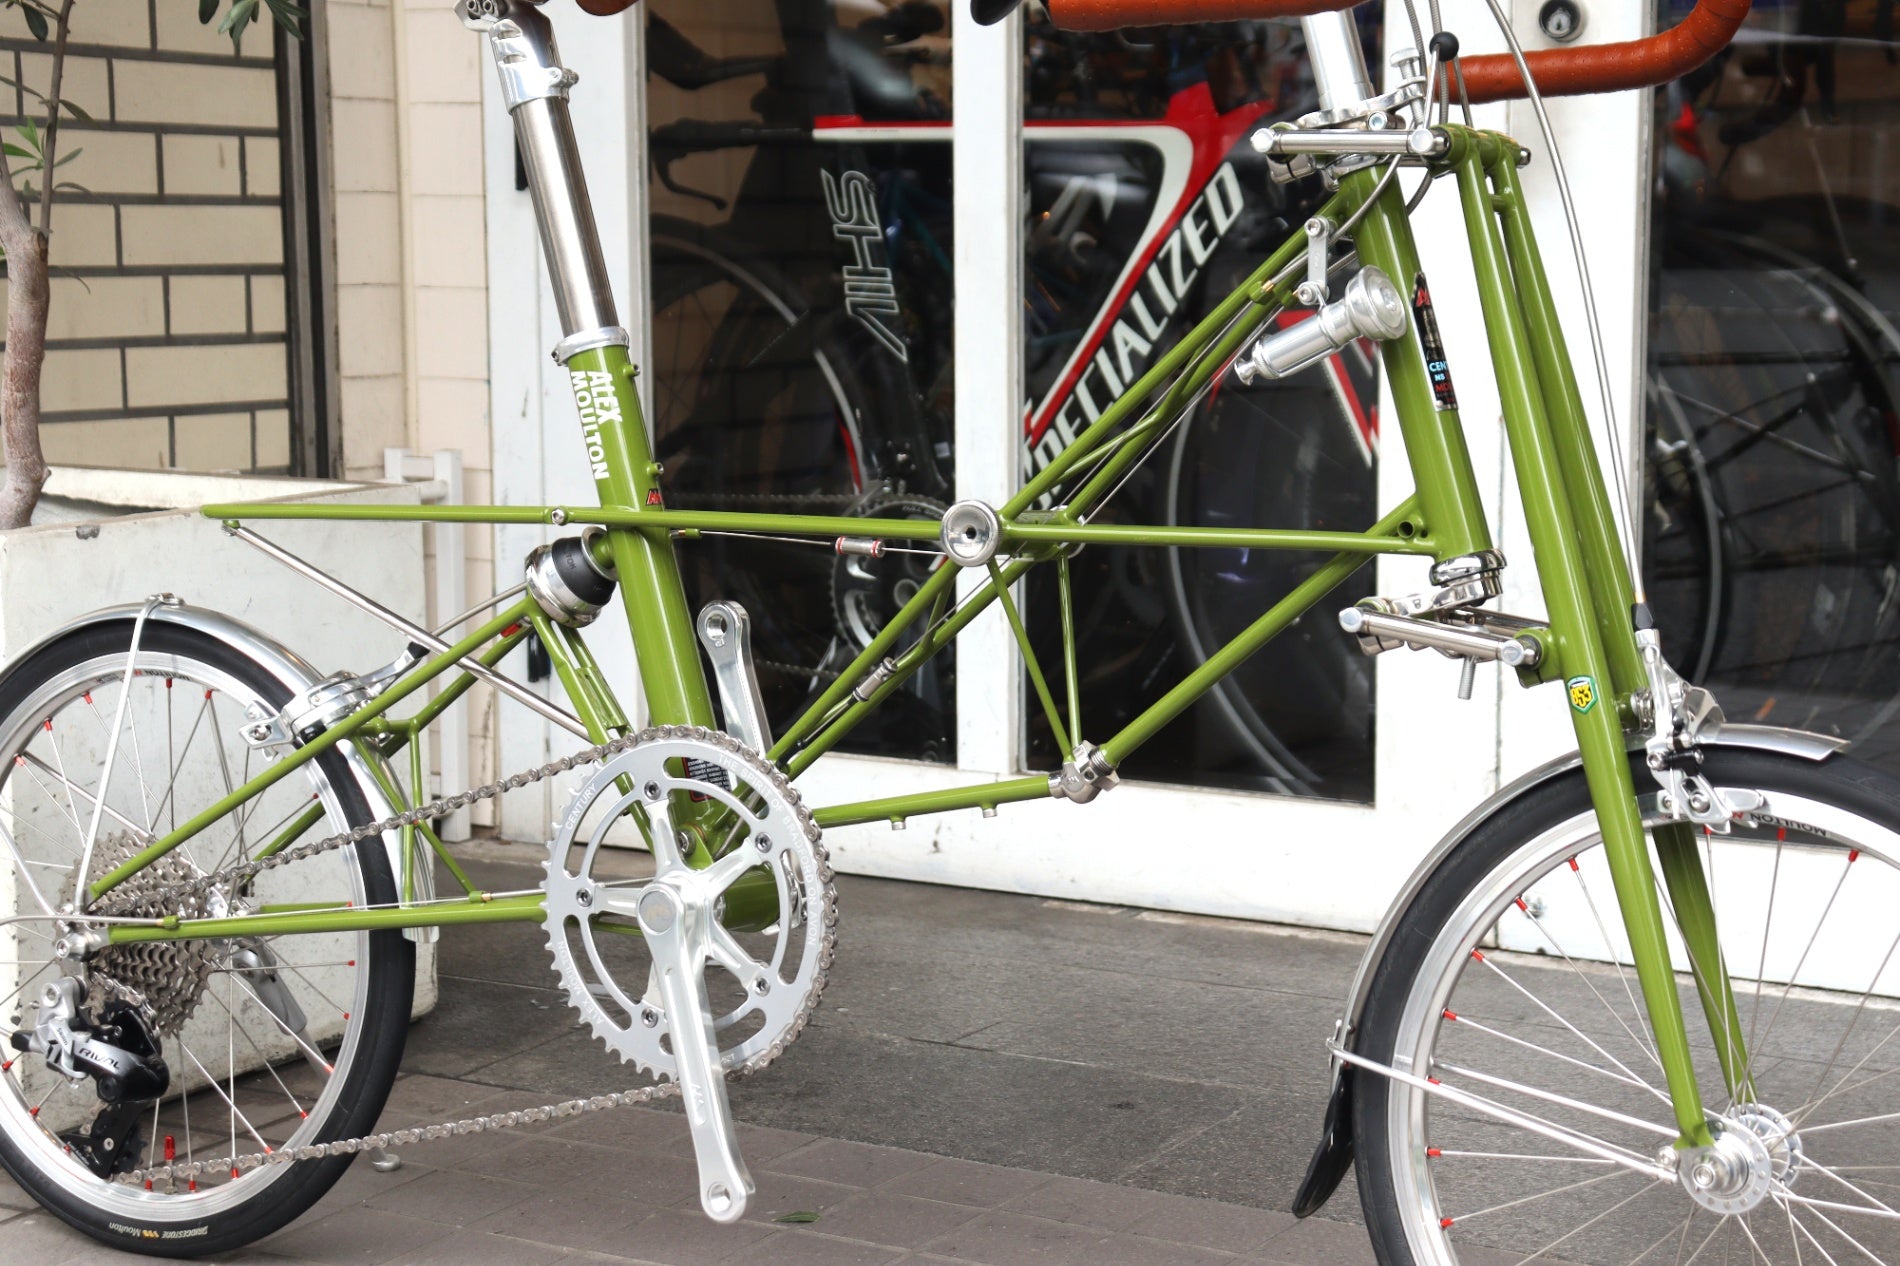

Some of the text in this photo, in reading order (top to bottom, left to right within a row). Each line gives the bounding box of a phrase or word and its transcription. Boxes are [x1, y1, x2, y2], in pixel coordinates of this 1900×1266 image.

[820, 168, 909, 363] SHIV
[1428, 361, 1448, 372] CEN
[586, 370, 623, 425] ALEX
[570, 370, 610, 480] MOULTON
[565, 783, 597, 830] CENTURY
[1750, 812, 1827, 837] MOULTON
[807, 887, 818, 905] ON
[807, 910, 818, 946] AVON
[78, 1046, 121, 1070] RIVAL
[108, 1222, 142, 1237] Moulton
